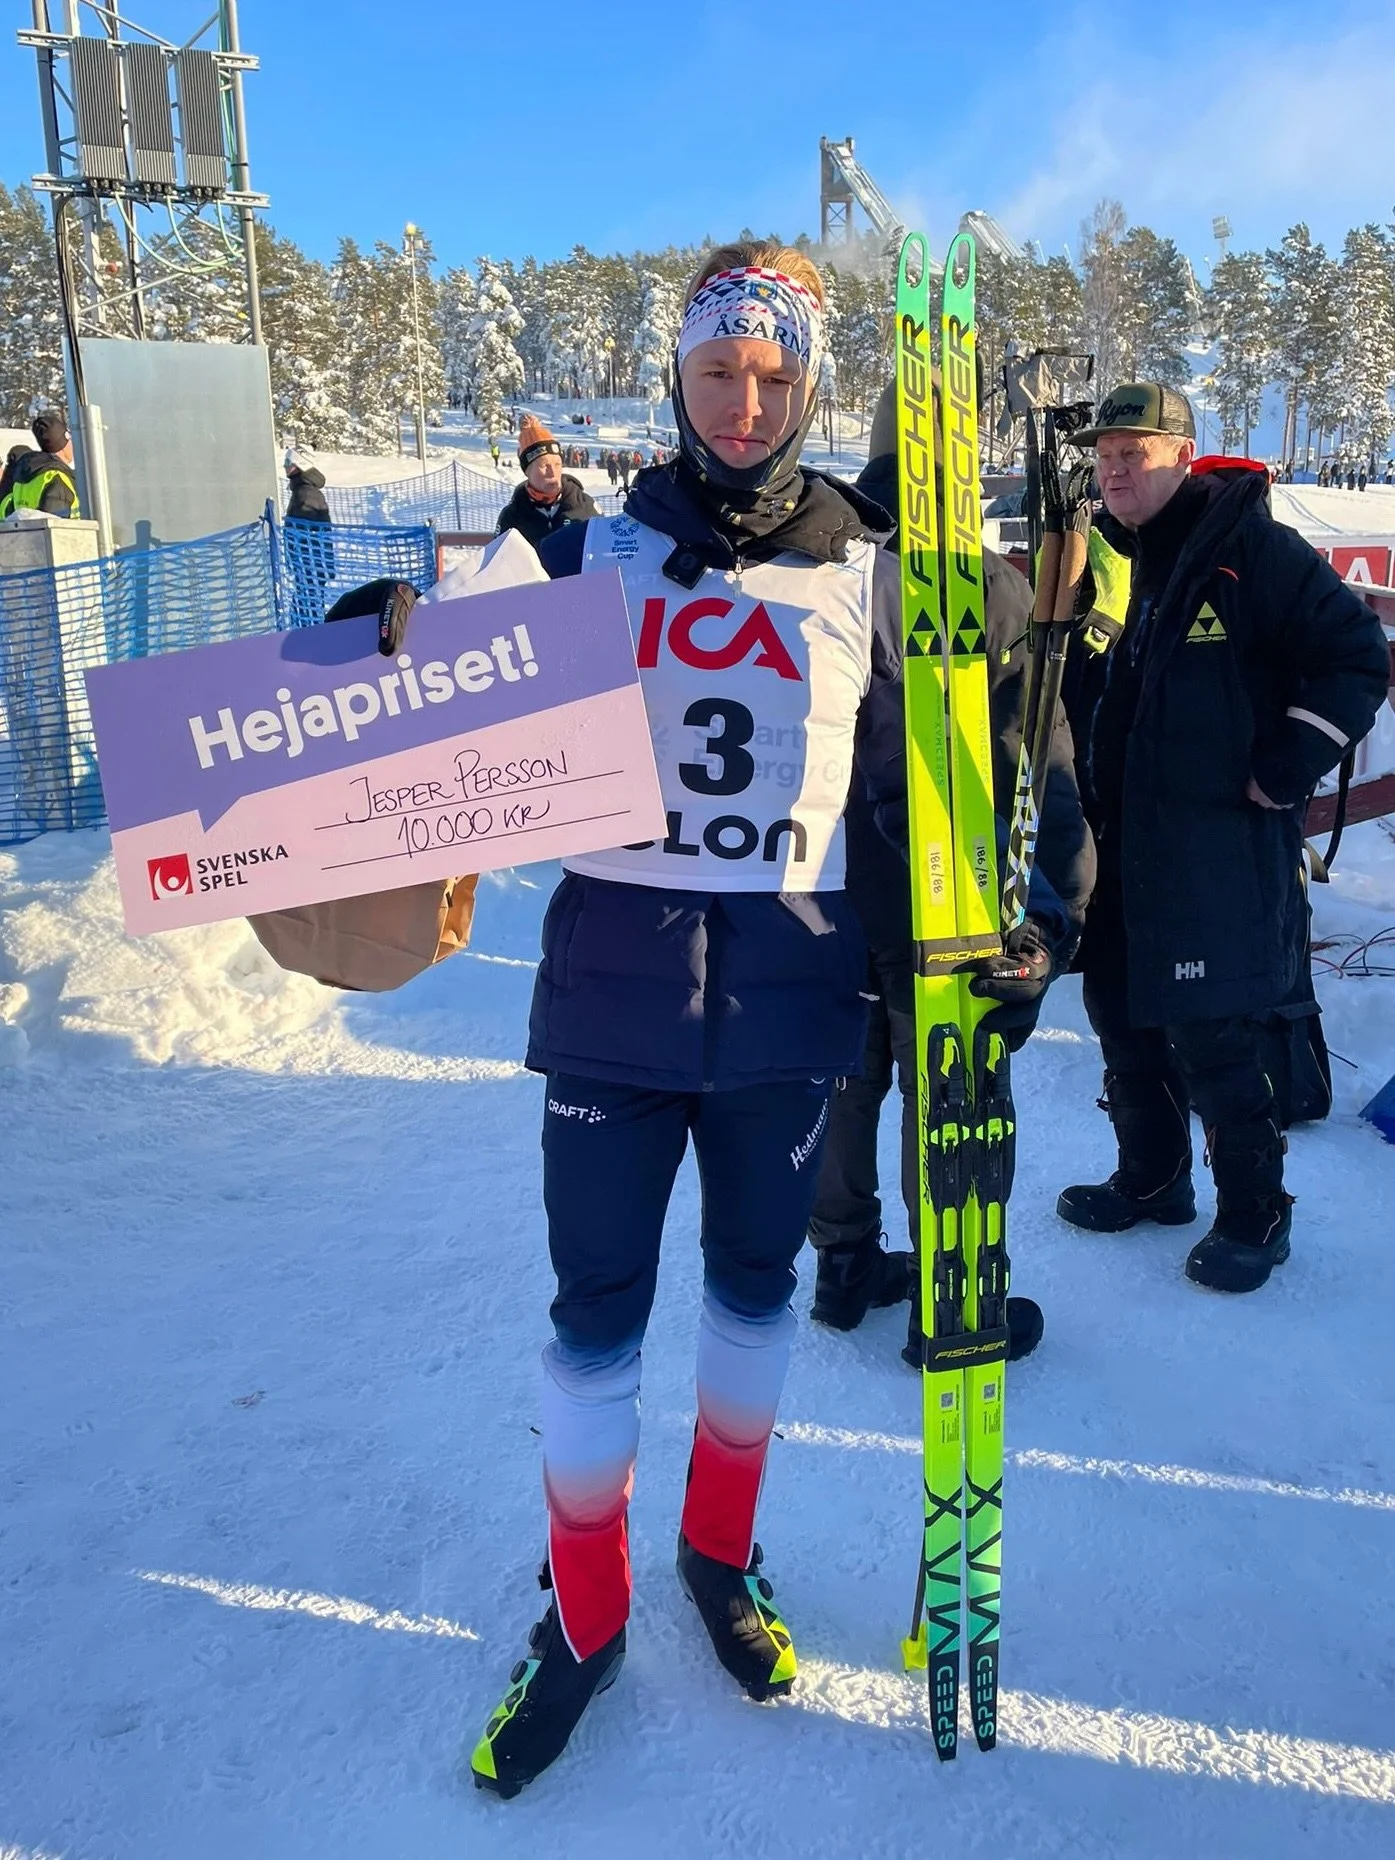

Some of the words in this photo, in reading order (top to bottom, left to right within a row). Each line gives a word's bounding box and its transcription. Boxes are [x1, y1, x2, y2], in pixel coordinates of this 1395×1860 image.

[901, 313, 934, 587] FISCHER
[948, 313, 979, 587] FISCHER
[613, 539, 638, 547] Smart
[617, 552, 634, 560] Cup
[637, 597, 803, 682] ICA
[189, 623, 540, 769] Hejapriset!
[678, 697, 755, 797] 3
[346, 776, 455, 824] JESPER
[453, 749, 569, 800] PERSSON
[398, 807, 494, 859] 10.000
[196, 844, 290, 875] SVENSKA
[199, 871, 249, 893] SPEL
[926, 946, 1003, 964] FISCHER
[1175, 960, 1206, 981] HH
[548, 1098, 589, 1120] CRAFT
[934, 1339, 1008, 1360] FISCHER
